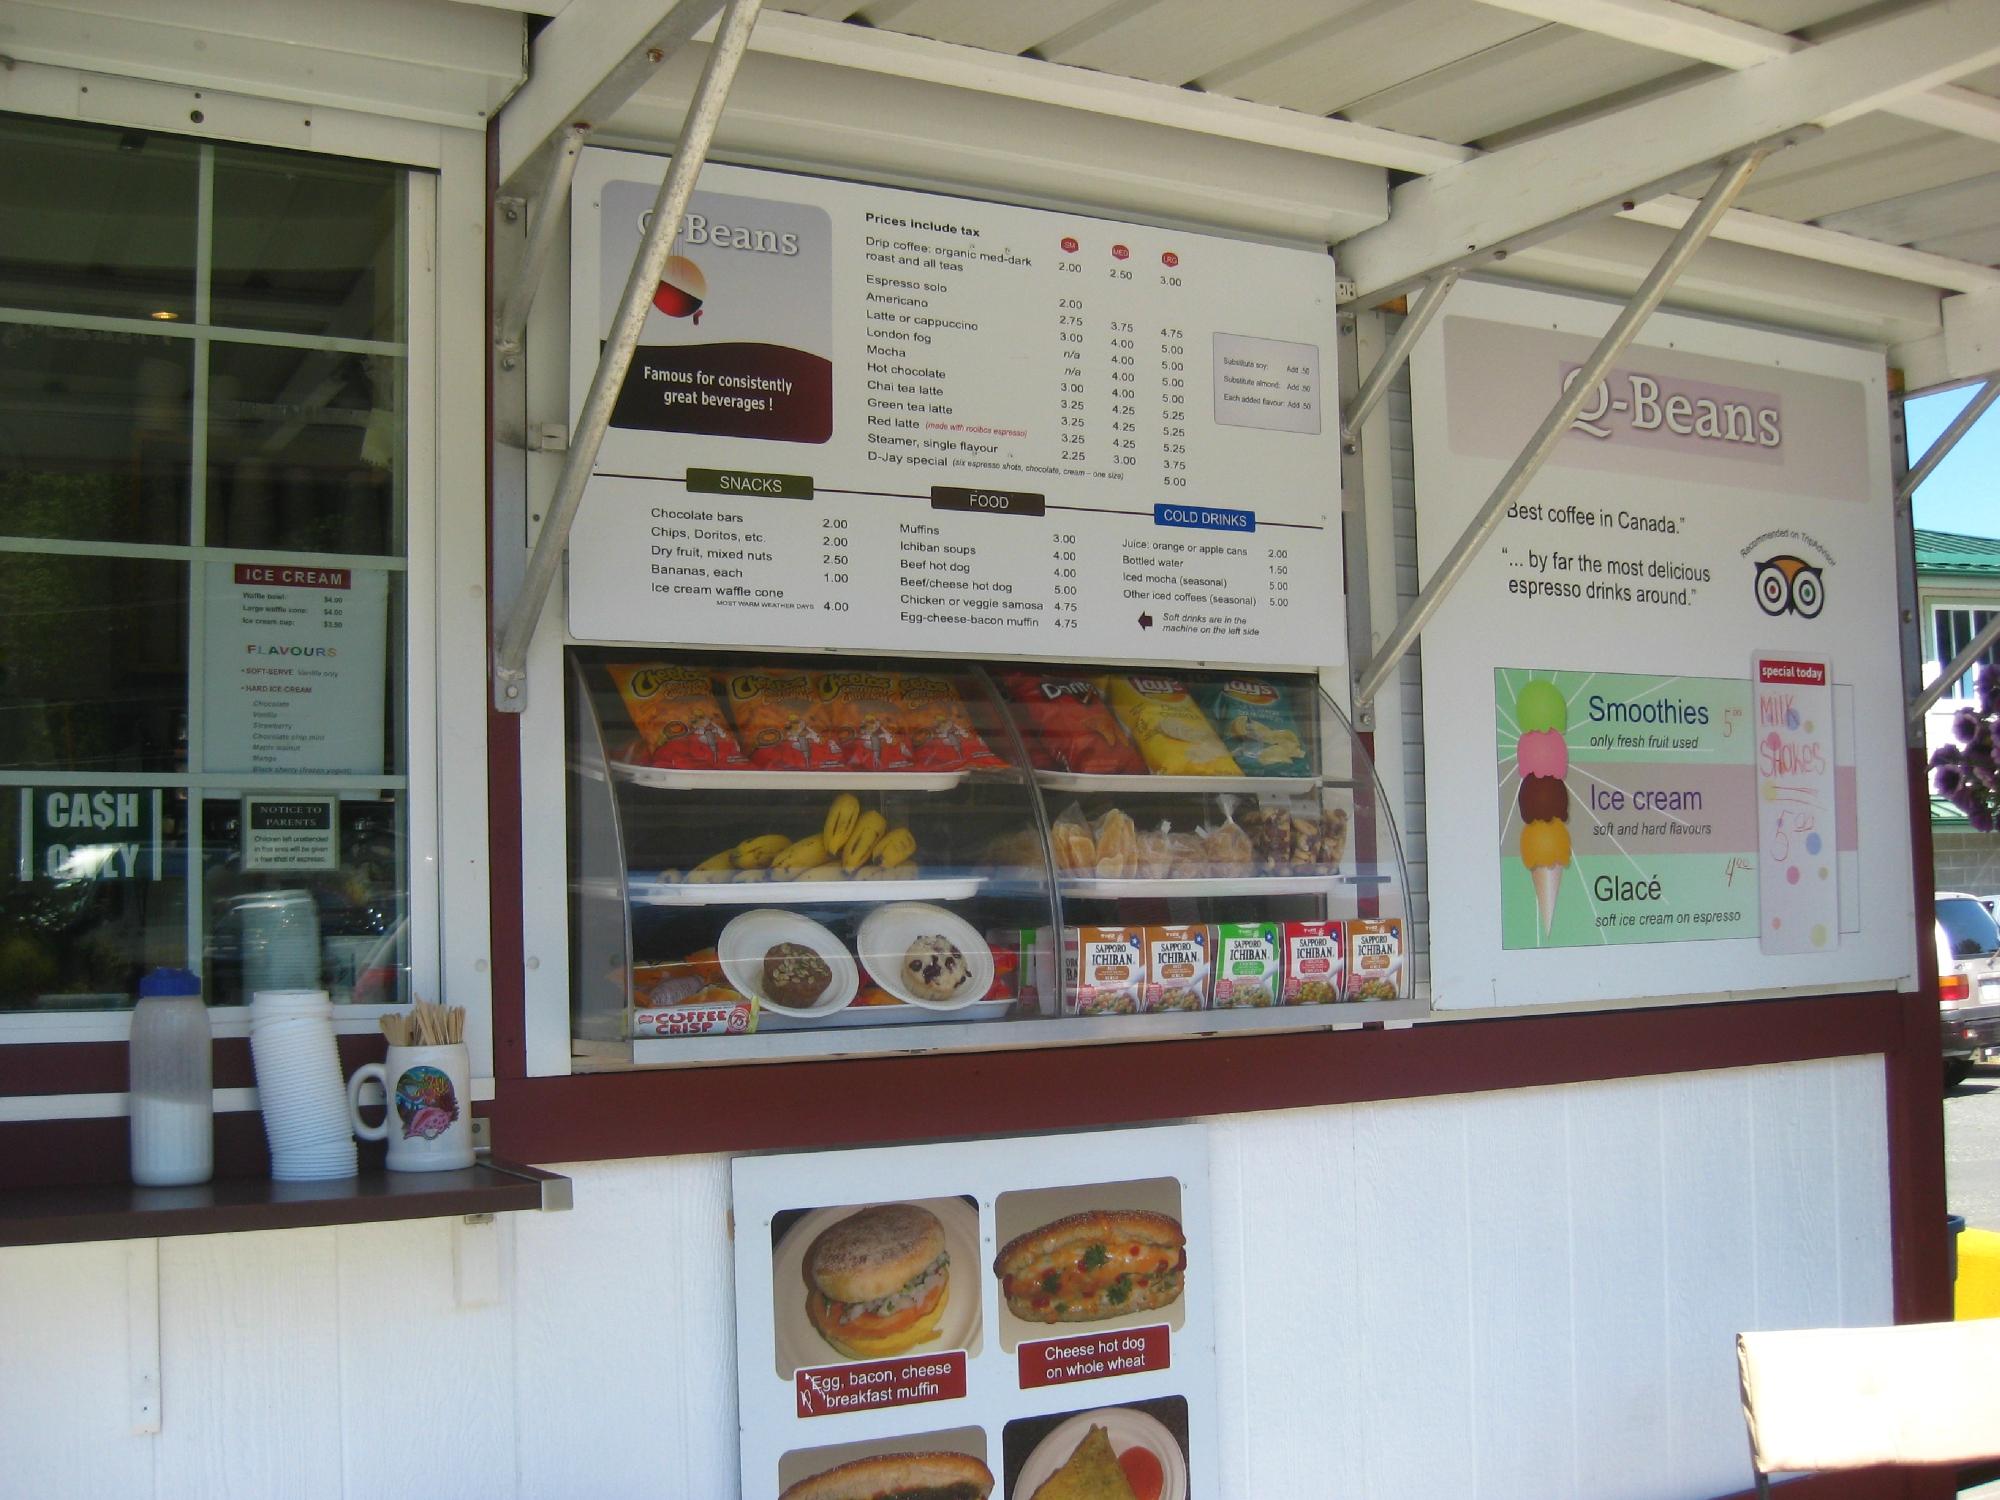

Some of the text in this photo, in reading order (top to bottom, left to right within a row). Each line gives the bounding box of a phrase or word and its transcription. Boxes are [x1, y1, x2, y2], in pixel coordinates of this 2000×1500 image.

[866, 213, 980, 237] Prices include tax
[866, 237, 1032, 267] Drip coffee: organic med-dark
[866, 252, 1182, 287] roast and all teas 2.00 2.50 3.00
[867, 275, 1083, 310] Espresso solo 2.00
[866, 292, 1183, 338] Americano 2.75 3.75 4.75
[867, 310, 978, 331] Latte or cappuccino
[867, 328, 931, 344] London fog
[867, 345, 906, 358] Mocha
[644, 366, 793, 395] Famous for consistently
[867, 363, 946, 379] Hot chocolate
[664, 390, 698, 406] great
[701, 393, 765, 411] beverages
[1562, 367, 1782, 448] Q-Beans
[868, 416, 919, 429] Red latte
[868, 451, 948, 467] D-Jay special
[720, 476, 782, 493] SNACKS
[970, 494, 1009, 509] FOOD
[652, 508, 848, 529] Chocolate bars 2.00
[1164, 509, 1247, 527] COLD DRINKS
[1548, 506, 1595, 526] coffee
[1600, 509, 1613, 528] in
[652, 527, 848, 547] Chips, Doritos, etc. 2.00
[900, 524, 1076, 544] Muffins 3.00
[652, 546, 848, 565] Dry fruit, mixed nuts 2.50
[900, 542, 1076, 561] Ichiban soups 4.00
[652, 564, 849, 583] Bananas, each 1.00
[900, 560, 1076, 578] Beef hot dog 4.00
[1123, 556, 1287, 575] Bottled water 1.50
[1529, 550, 1547, 573] by
[1553, 552, 1573, 570] far
[1579, 554, 1602, 573] the
[1607, 559, 1643, 577] most
[1648, 560, 1710, 582] delicious
[246, 569, 342, 585] ICE CREAM
[1123, 573, 1288, 591] Iced mocha (seasonal) 5.00
[652, 583, 784, 598] Ice cream waffle cone
[1509, 579, 1581, 599] espresso
[1586, 582, 1631, 601] drinks
[824, 602, 849, 612] 4.00
[900, 595, 1077, 612] Chicken or veggie samosa 4.75
[247, 645, 337, 657] FLAVOURS
[1762, 666, 1823, 681] special today
[1589, 696, 1709, 725] Smoothies
[1590, 735, 1698, 749] only fresh fruit used
[1591, 784, 1702, 811] Ice cream
[1593, 823, 1712, 836] soft and hard flavours
[1594, 874, 1661, 902] Glacé
[1595, 911, 1741, 927] soft ice cream on espresso
[1096, 945, 1126, 953] SAPPORO
[1234, 940, 1261, 948] SAPPORO
[1092, 954, 1133, 965] ICHIBAN
[1230, 949, 1267, 960] ICHIBAN
[656, 1011, 726, 1023] COFFEE
[656, 1022, 713, 1034] CRISP
[1045, 1336, 1145, 1361] Cheese hot dog
[1046, 1354, 1145, 1378] on whole wheat
[812, 1362, 952, 1392] Egg, bacon, cheese
[826, 1382, 938, 1408] breakfast muffin
